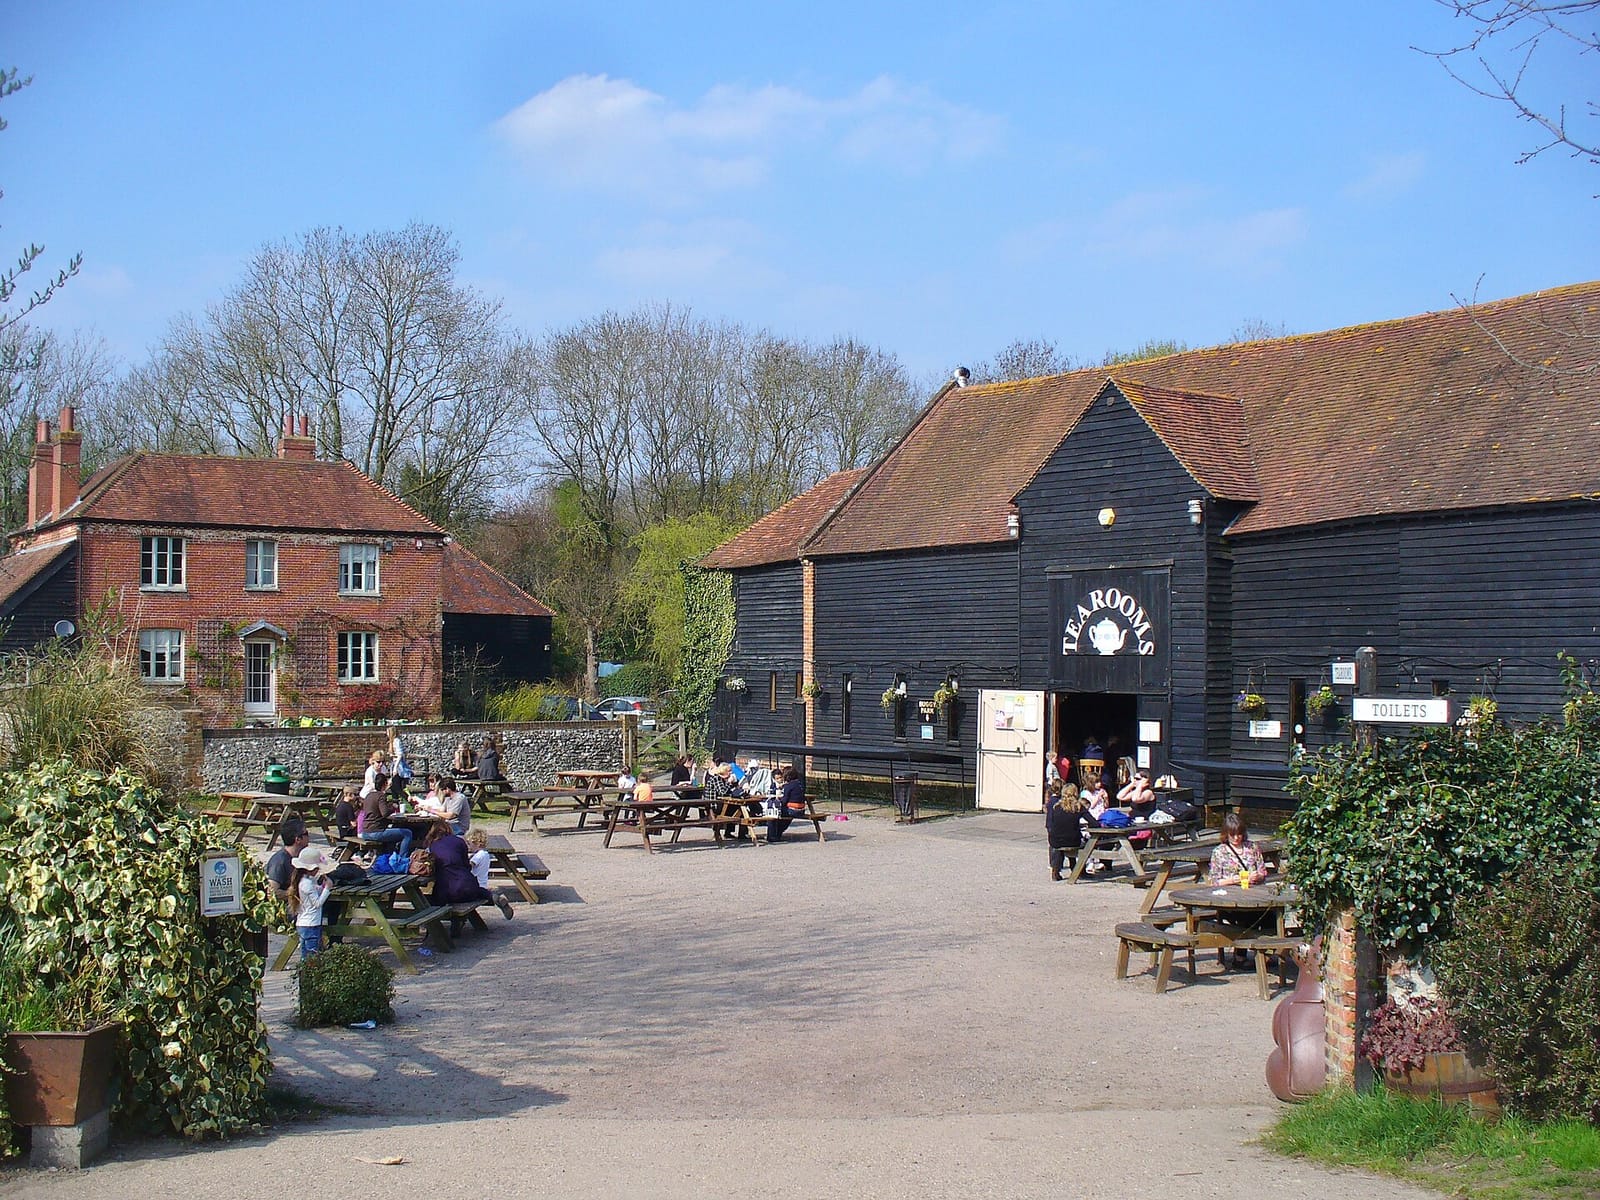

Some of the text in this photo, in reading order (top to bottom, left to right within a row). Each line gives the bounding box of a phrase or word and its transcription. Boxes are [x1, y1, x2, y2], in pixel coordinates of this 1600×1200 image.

[1063, 588, 1155, 655] TEA ROOMS
[920, 707, 935, 715] PARK
[1371, 703, 1427, 718] TOILETS
[209, 877, 233, 887] WASH
